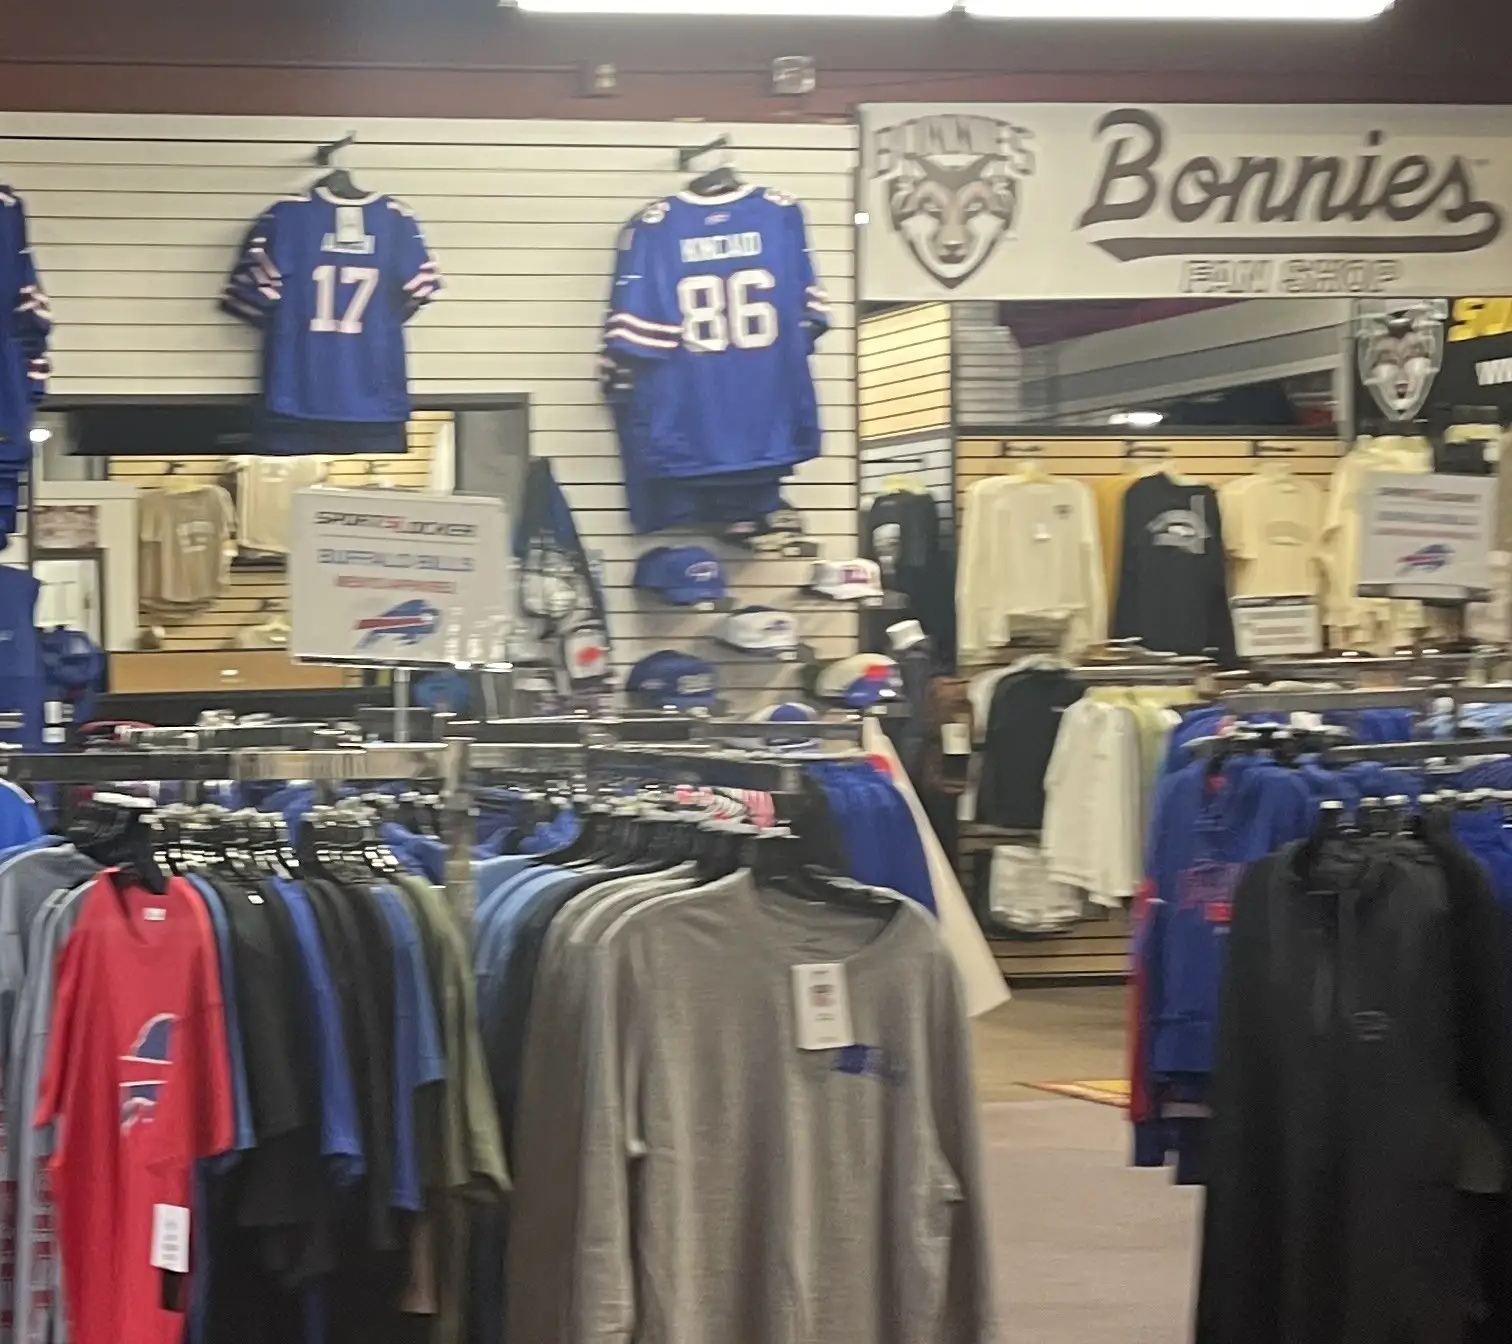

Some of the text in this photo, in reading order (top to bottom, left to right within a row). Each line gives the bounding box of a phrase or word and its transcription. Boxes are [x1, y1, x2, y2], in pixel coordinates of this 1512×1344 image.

[1074, 108, 1500, 236] Bonnies
[309, 265, 380, 334] 17
[676, 268, 779, 353] 86
[1180, 259, 1403, 294] FAN SHOP
